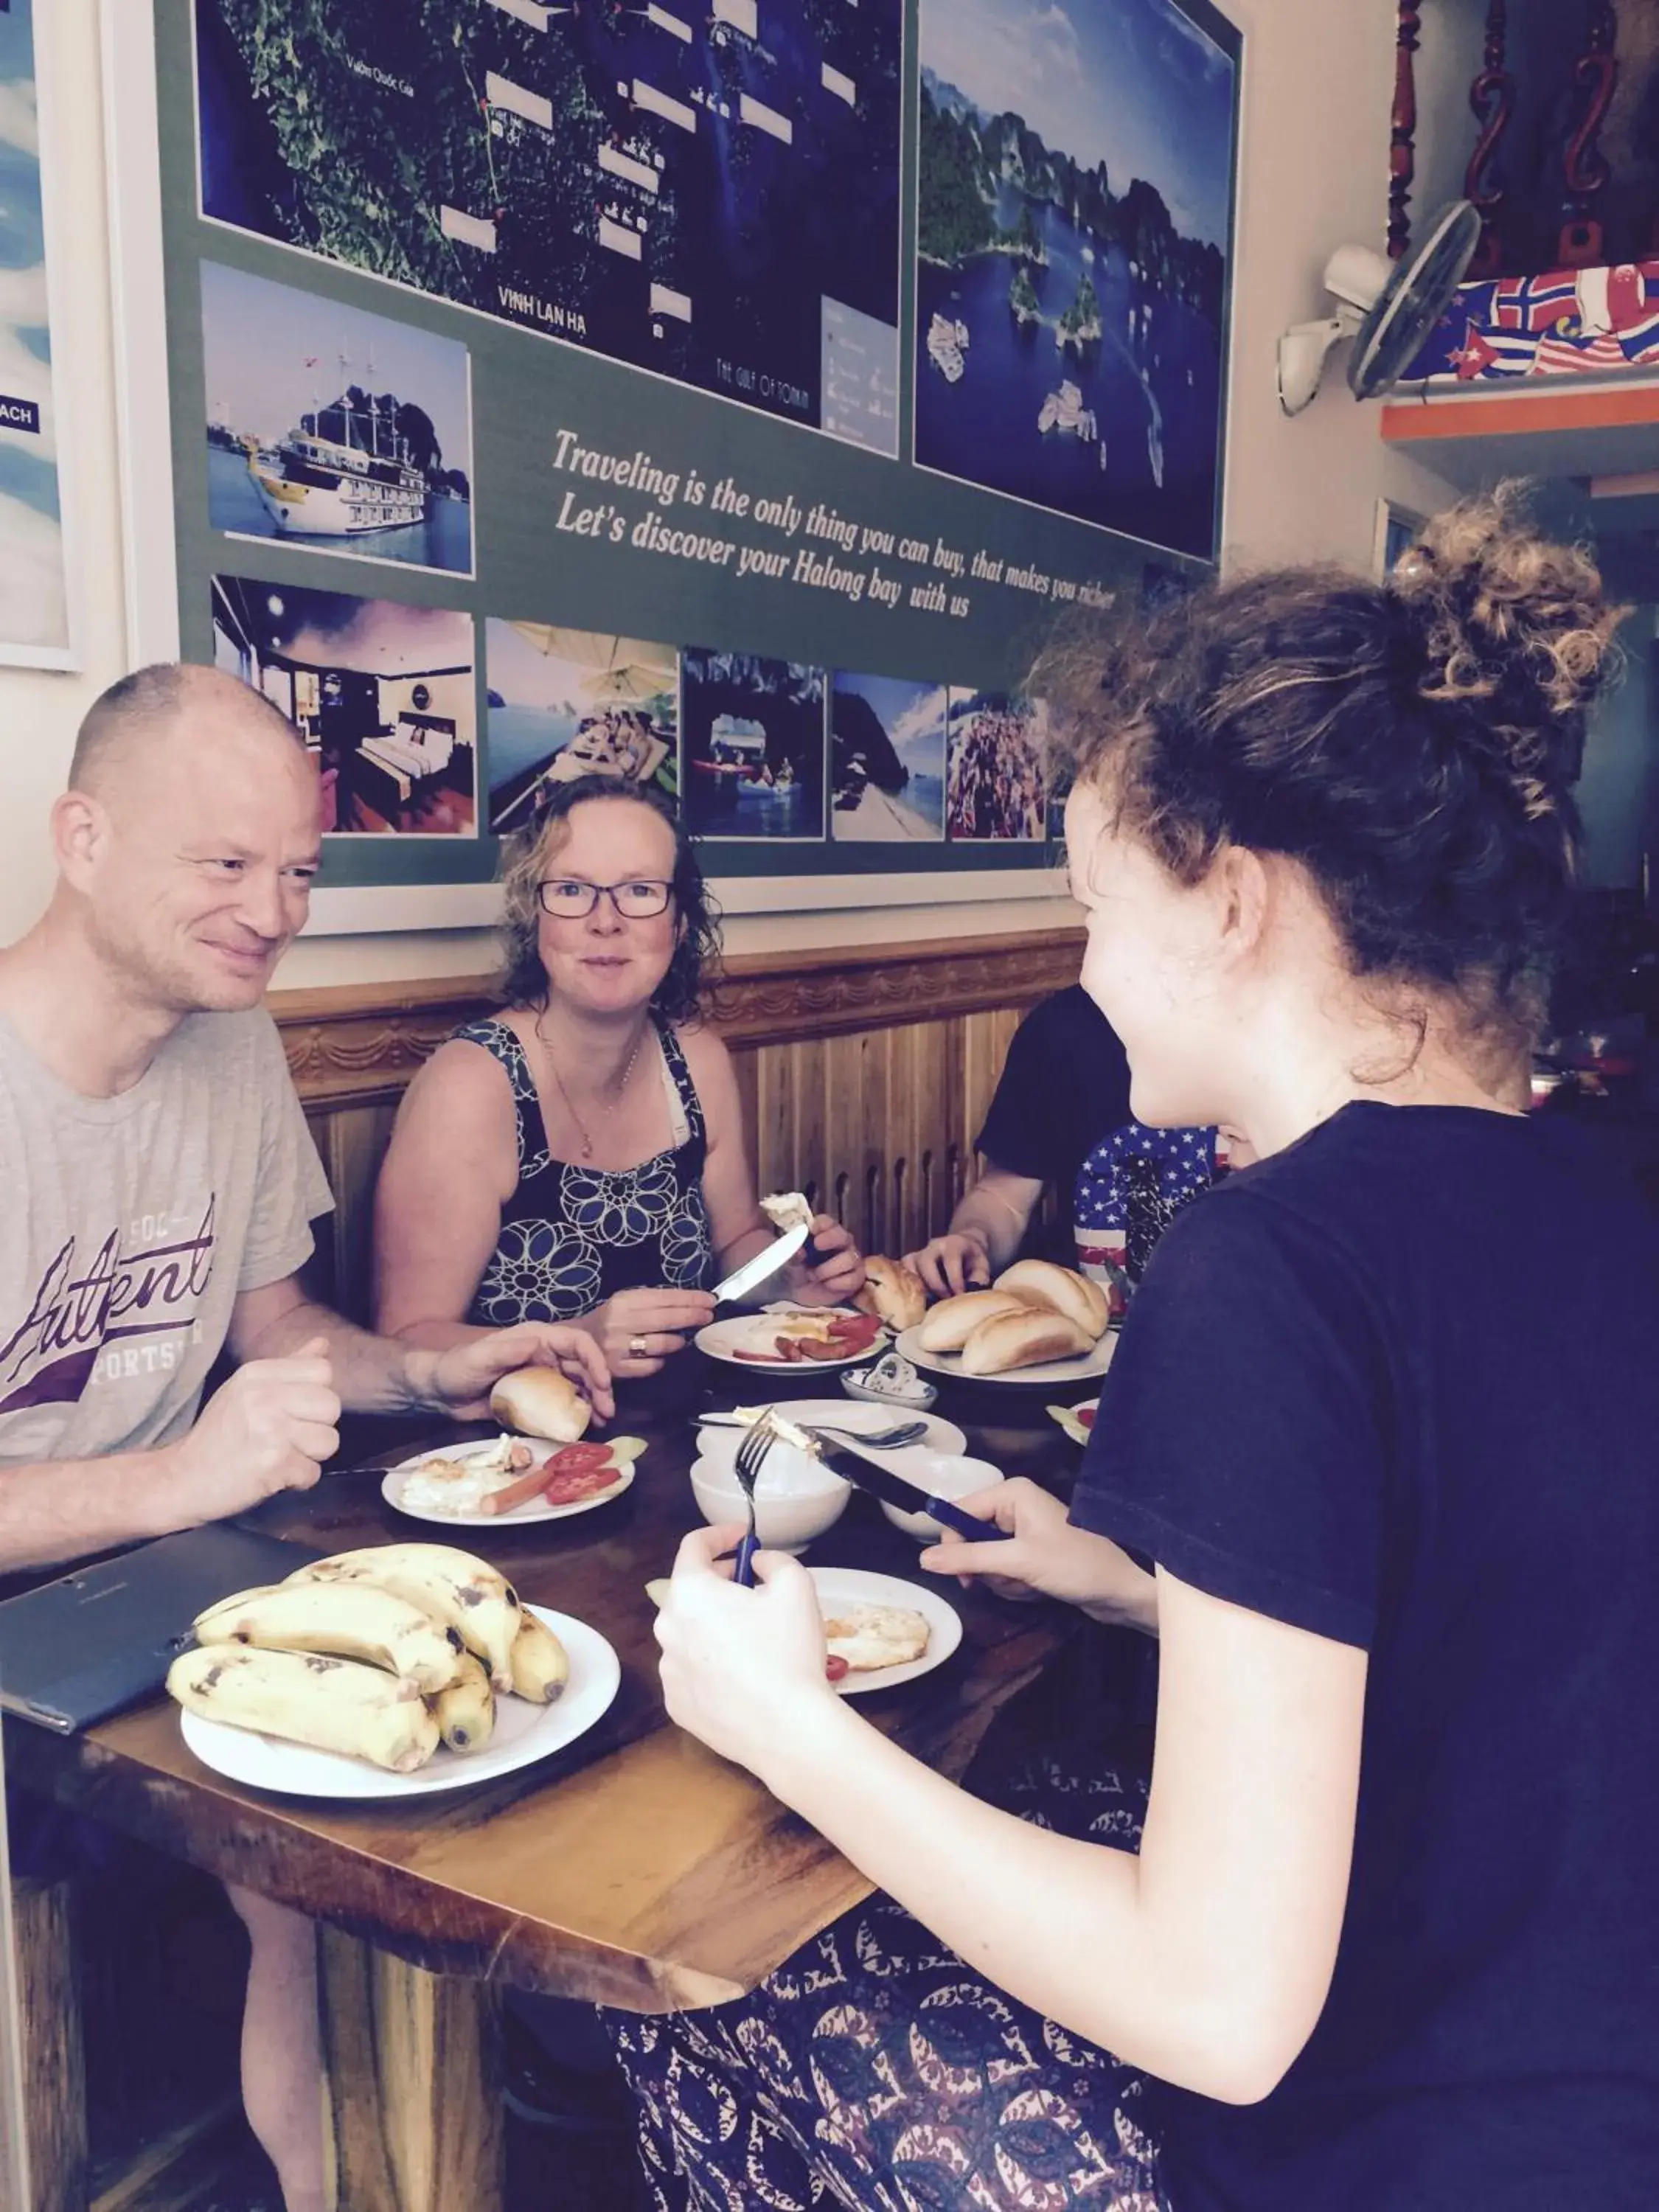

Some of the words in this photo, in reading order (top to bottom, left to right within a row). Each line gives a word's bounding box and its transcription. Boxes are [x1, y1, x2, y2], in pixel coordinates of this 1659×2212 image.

[537, 299, 564, 327] LAN
[553, 429, 680, 505] Traveling
[684, 470, 706, 505] is
[710, 478, 750, 516] the
[754, 495, 802, 537] only
[805, 504, 858, 552] thing
[859, 526, 895, 555] you
[899, 538, 930, 563] can
[933, 538, 966, 578] buy,
[970, 549, 1004, 582] that
[1005, 563, 1051, 595] makes
[1050, 579, 1077, 602] you
[555, 492, 626, 542] Let's
[631, 511, 735, 566] discover
[736, 546, 790, 577] your
[792, 549, 866, 602] Halong
[868, 567, 901, 608] bay
[910, 582, 946, 612] with
[950, 595, 970, 617] us
